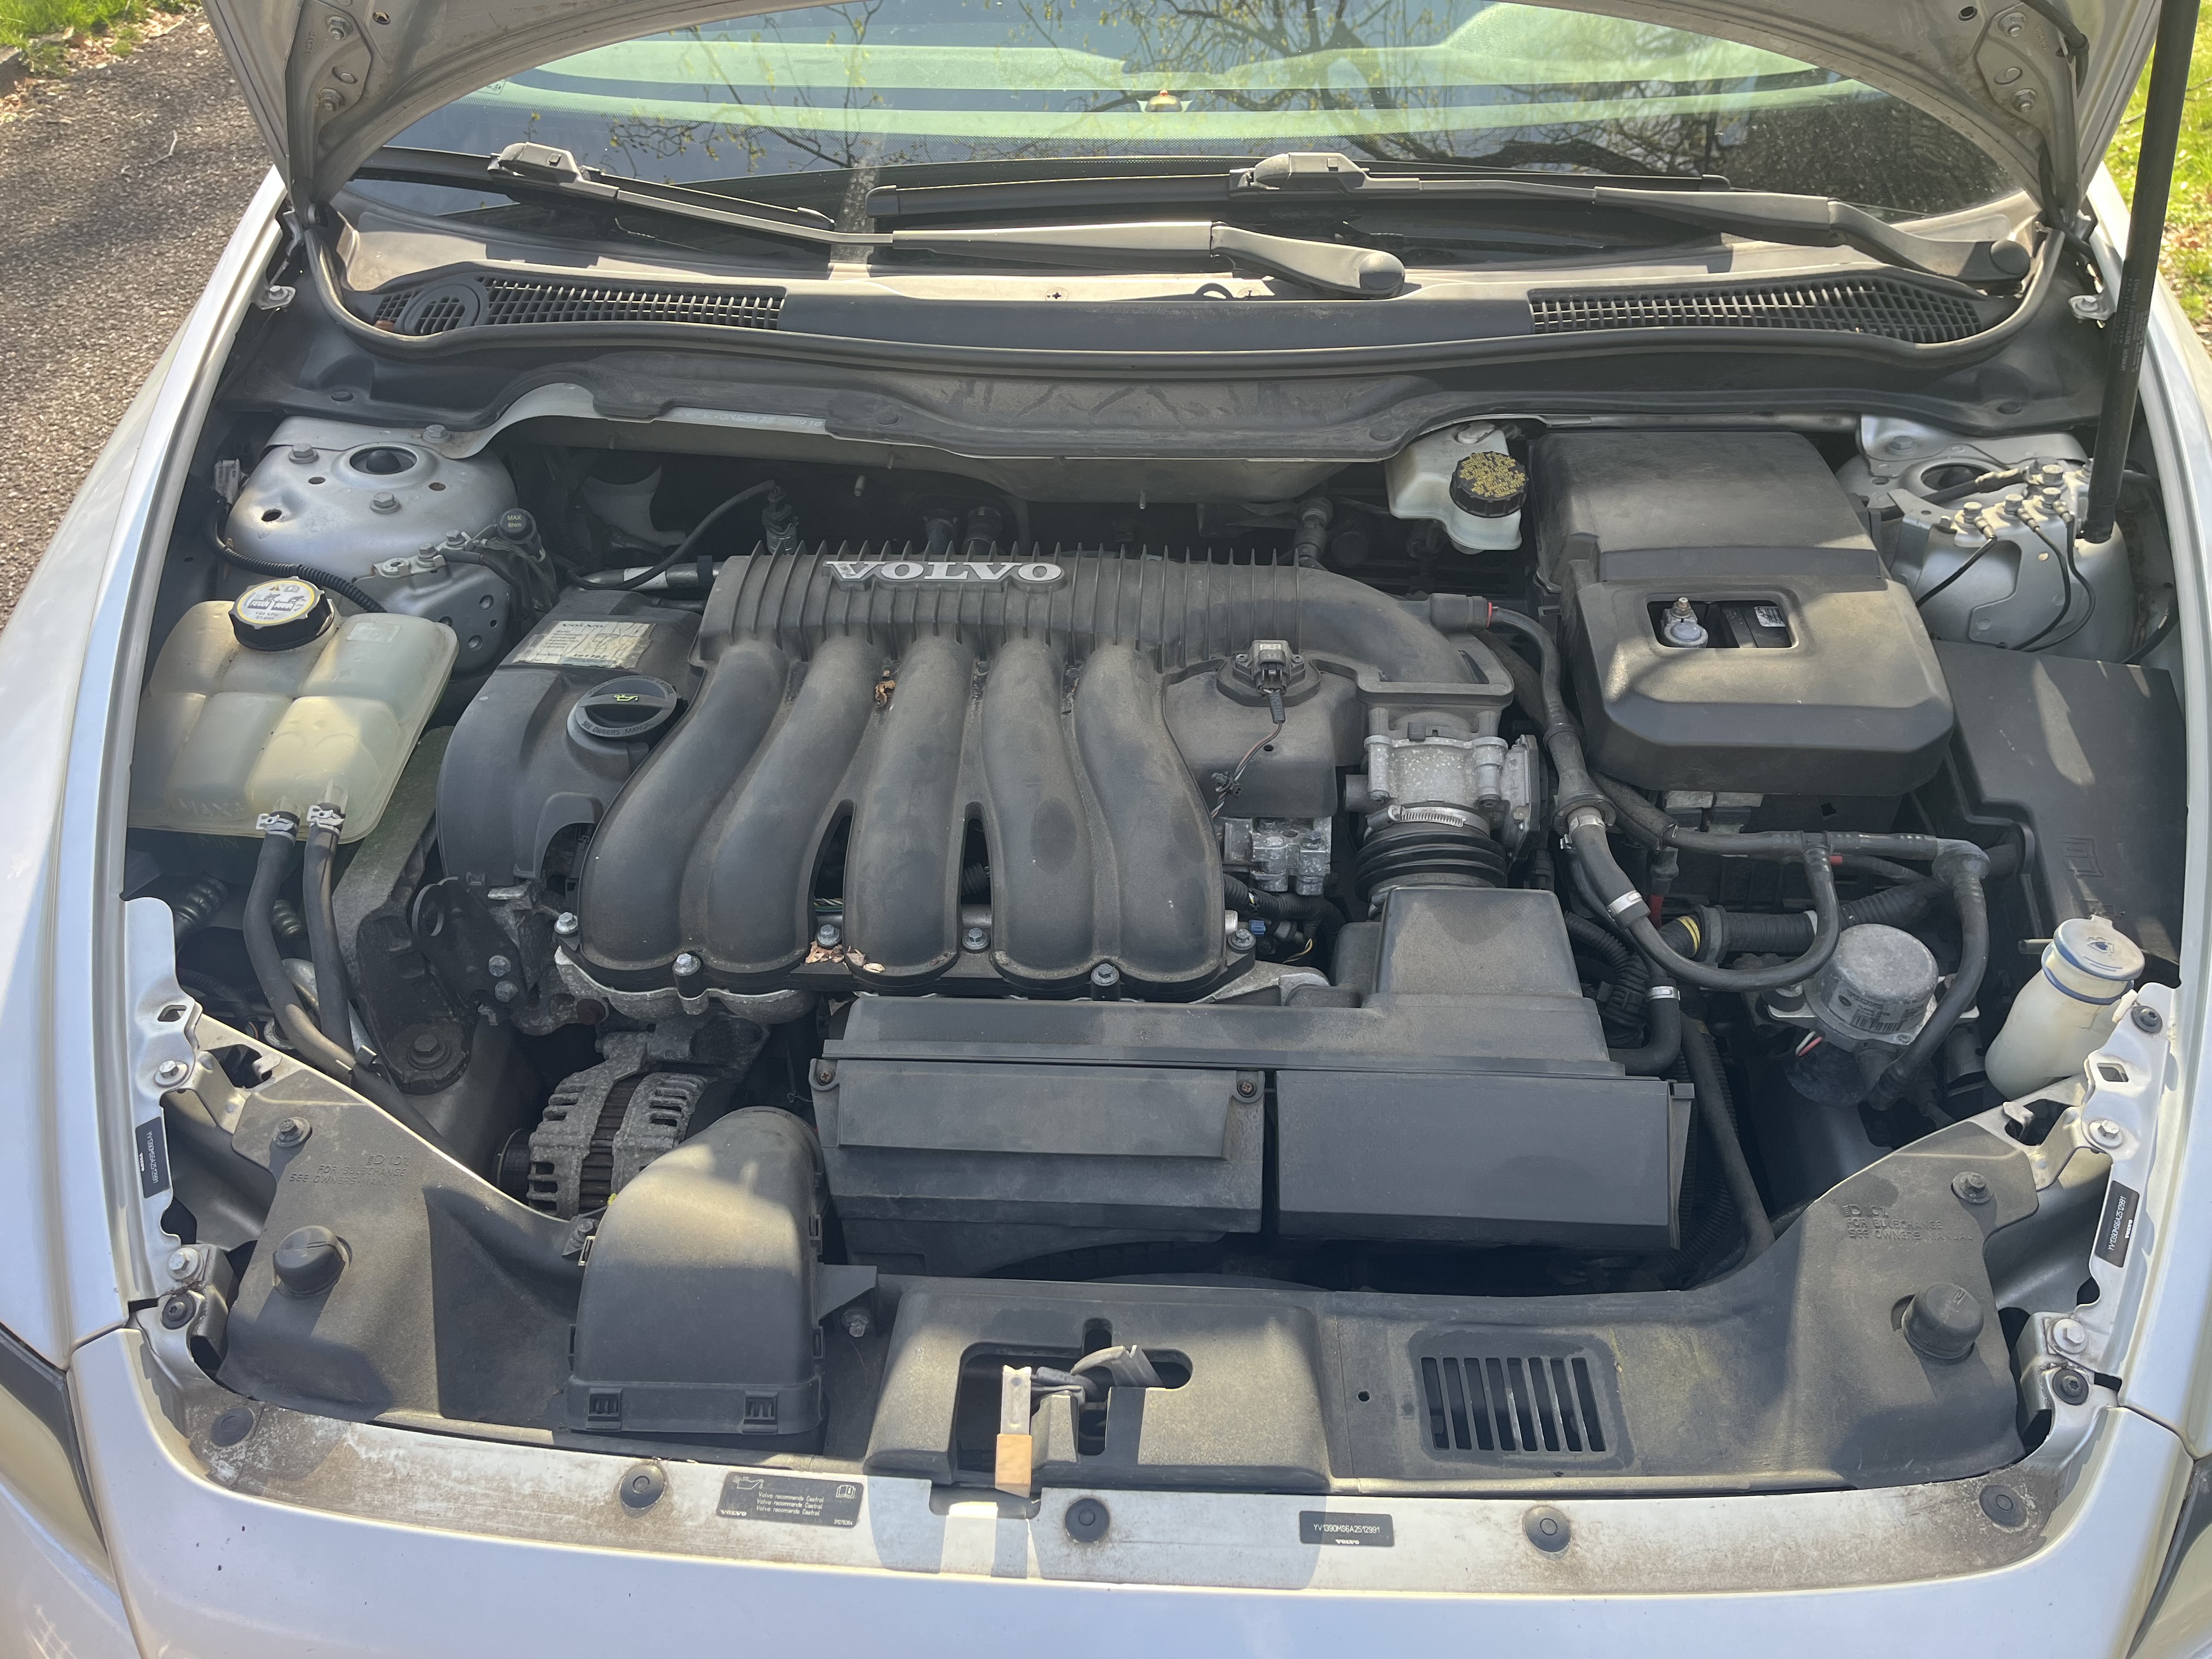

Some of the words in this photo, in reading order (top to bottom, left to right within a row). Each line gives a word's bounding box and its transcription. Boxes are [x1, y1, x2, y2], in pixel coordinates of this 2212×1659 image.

[826, 561, 1063, 582] VOLVO
[582, 720, 591, 730] SEE
[592, 726, 620, 735] OWNERS
[625, 721, 657, 733] MANUAL
[317, 1163, 338, 1174] FOR
[288, 1172, 309, 1183] SEE
[1846, 1217, 1868, 1229] FOR
[2125, 1219, 2133, 1239] VOLVO
[1313, 1523, 1380, 1534] YV1390MS6A2512991
